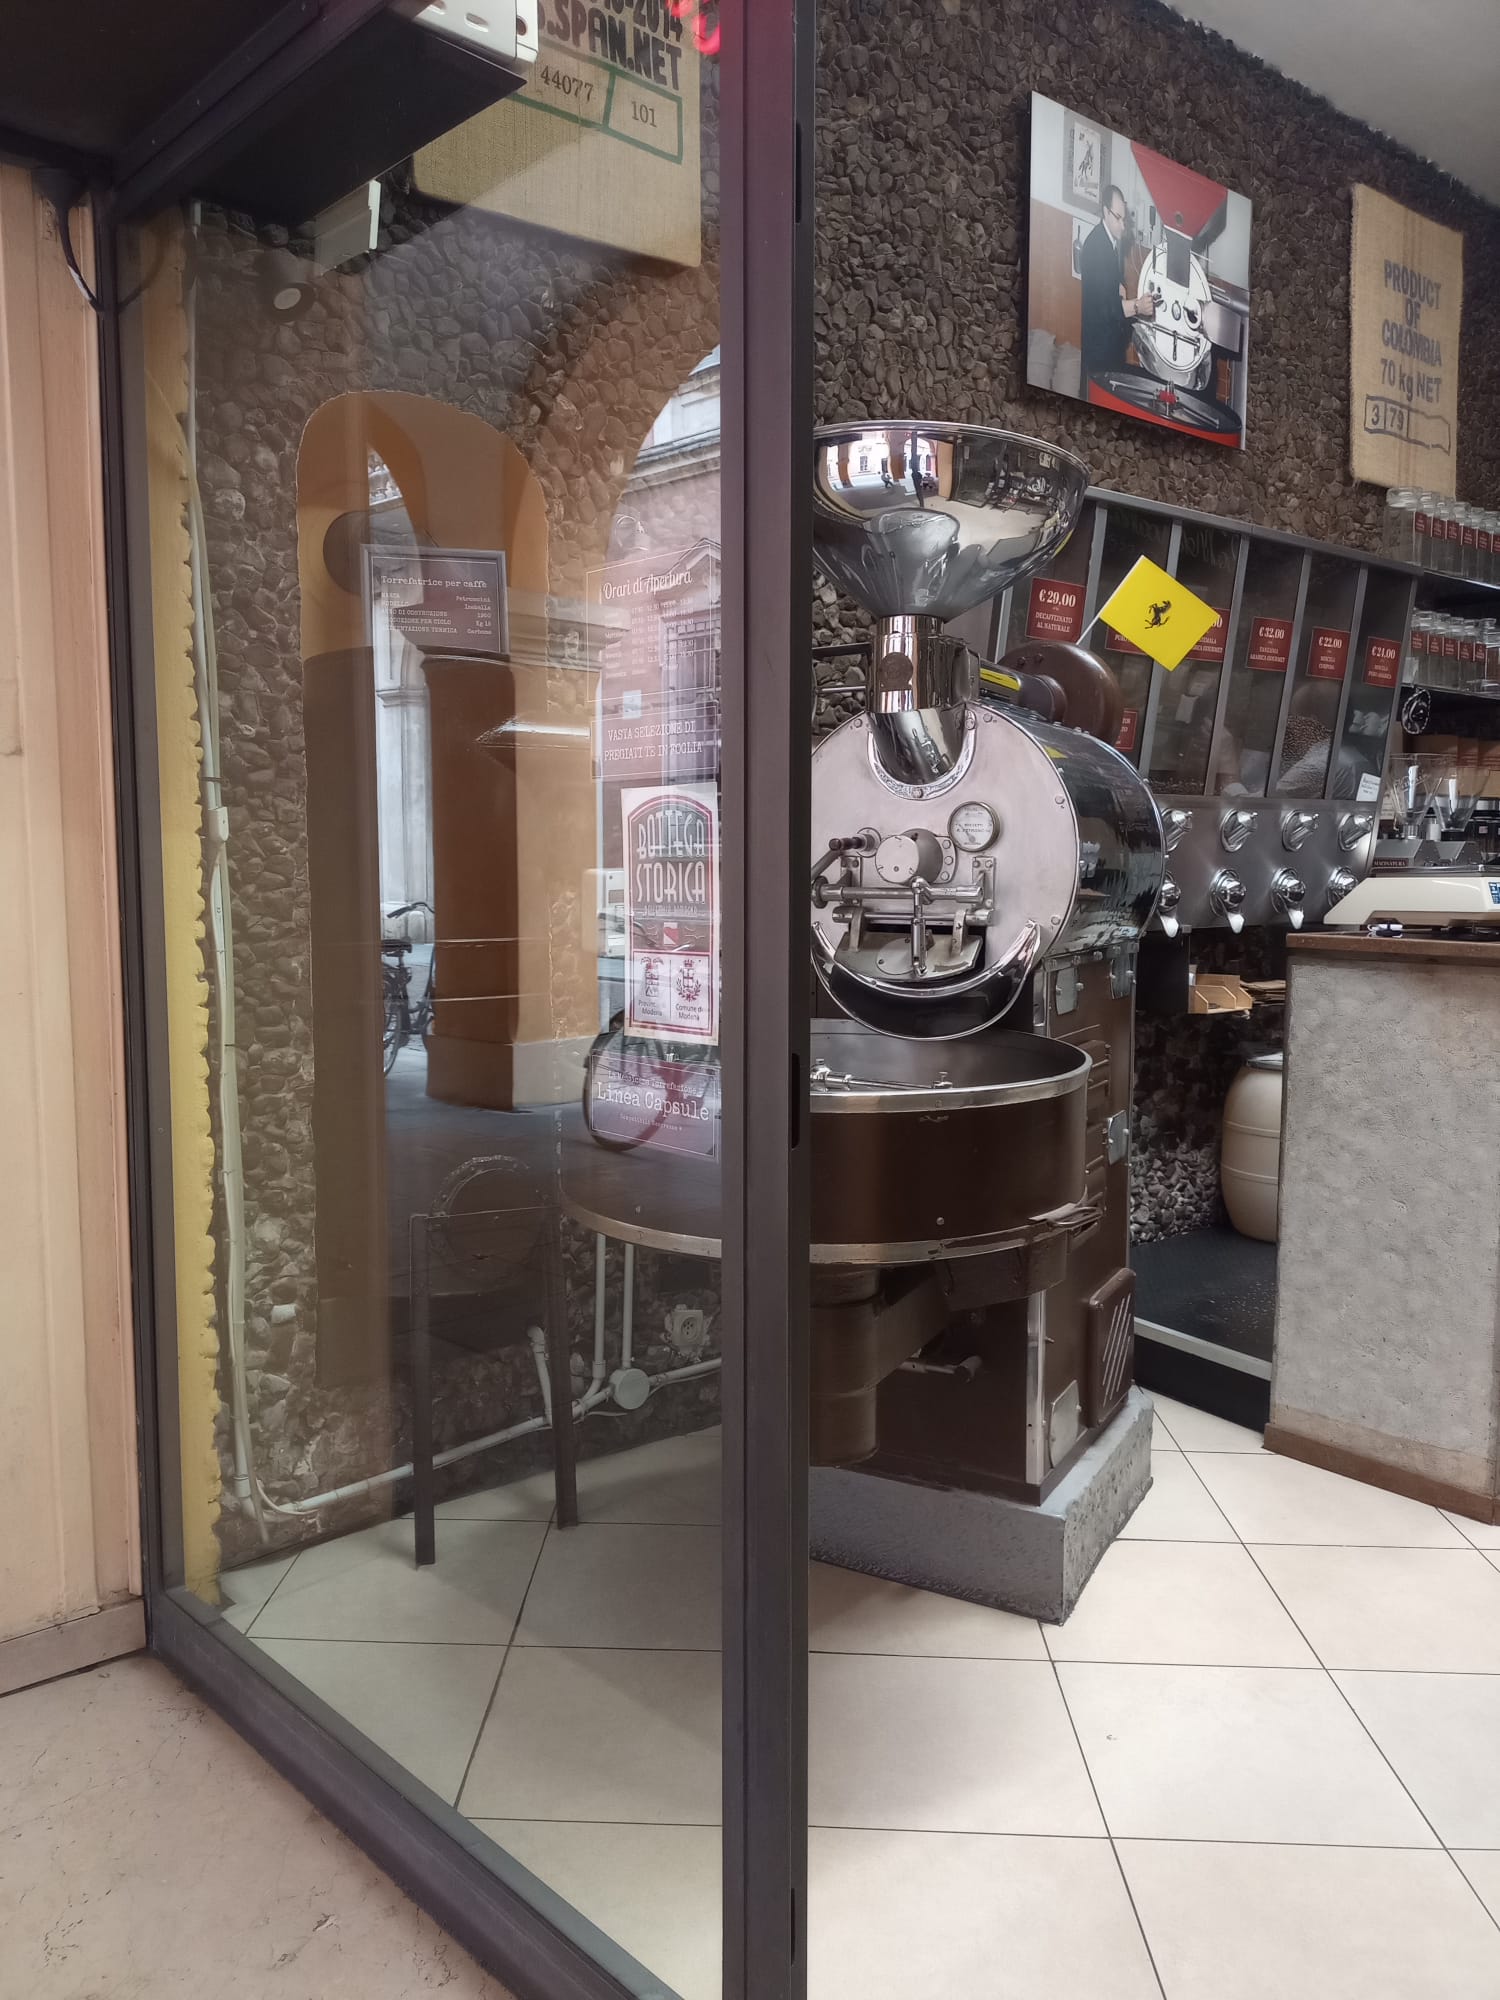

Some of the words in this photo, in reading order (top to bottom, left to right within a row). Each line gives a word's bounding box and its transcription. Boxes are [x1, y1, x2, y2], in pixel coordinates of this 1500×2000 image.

[540, 65, 594, 102] 44077
[631, 101, 657, 128] 101
[1384, 259, 1442, 310] PRODUCT
[1405, 298, 1421, 328] OF
[1382, 318, 1442, 367] COLOMBIA
[1381, 358, 1396, 386] 70
[1399, 364, 1414, 402] kg
[1416, 371, 1442, 403] NET
[1371, 404, 1380, 426] 3
[1389, 407, 1405, 431] 79
[603, 582, 632, 600] Orari
[633, 577, 643, 594] di
[645, 570, 693, 596] Apertura
[608, 728, 633, 741] VASTA
[634, 722, 683, 739] SELEZIONE
[684, 720, 696, 733] DI
[604, 746, 643, 761] PREGIATI
[658, 744, 668, 757] IN
[669, 741, 703, 754] FOGLIA
[636, 809, 705, 860] BOTTEGA
[636, 861, 706, 904] STORICA
[675, 1002, 697, 1013] Comune
[597, 1081, 640, 1107] Linea
[645, 1091, 710, 1121] Capsule
